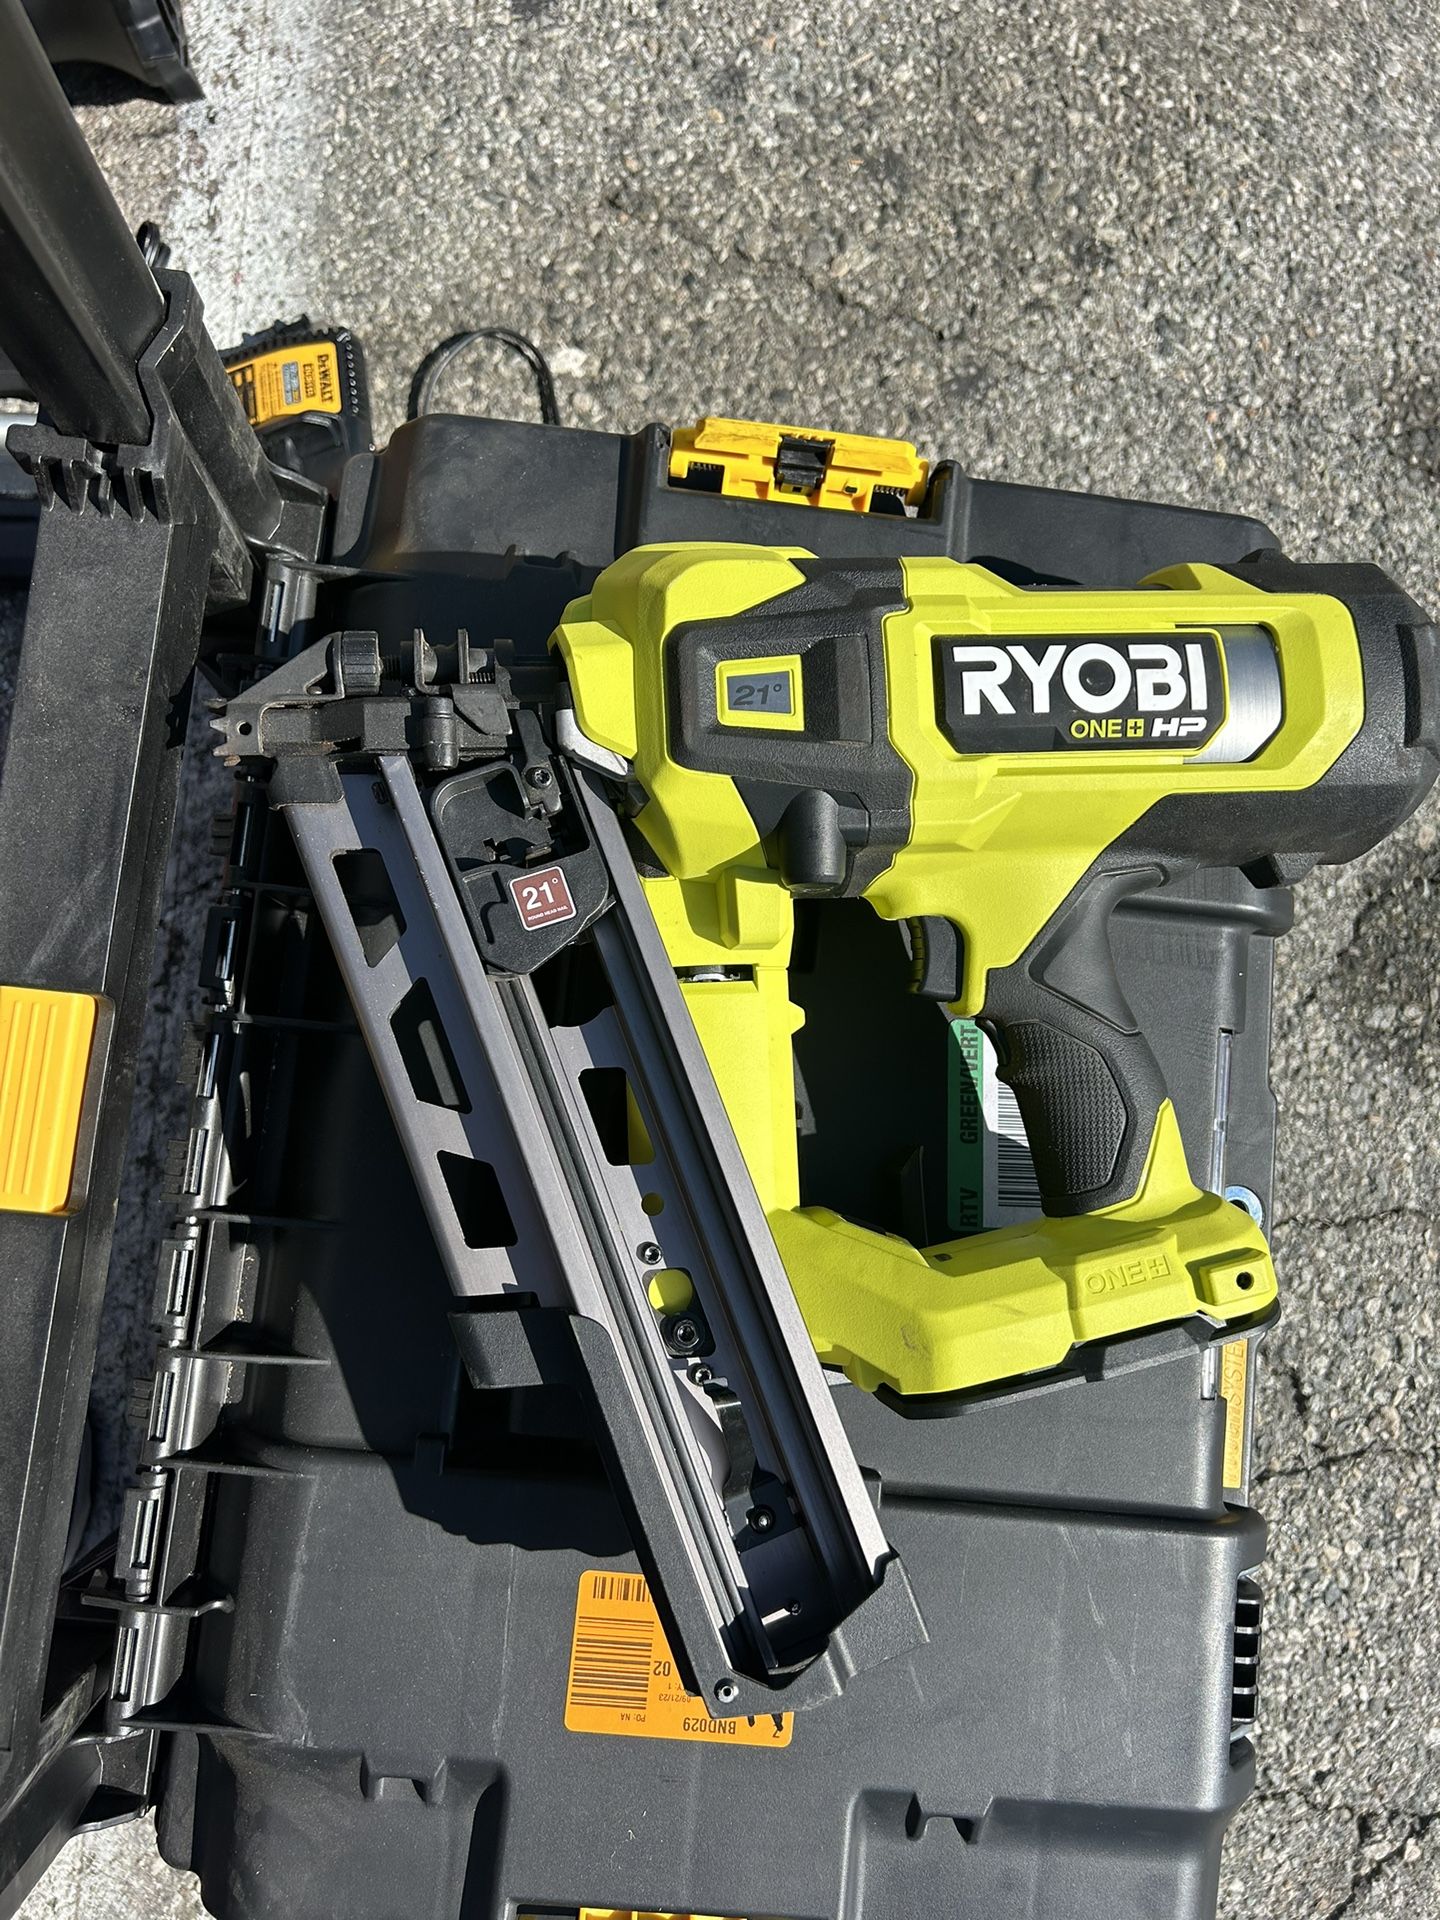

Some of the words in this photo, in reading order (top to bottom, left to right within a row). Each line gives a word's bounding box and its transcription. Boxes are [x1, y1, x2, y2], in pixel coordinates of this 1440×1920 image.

[952, 643, 1208, 715] RYOBI
[733, 683, 782, 706] 21°
[1150, 717, 1207, 737] HP
[522, 878, 558, 910] 21°
[960, 1024, 978, 1145] GREEN/VERT
[960, 1187, 978, 1227] RTV
[653, 1661, 671, 1677] 02
[620, 1712, 631, 1721] NA
[683, 1716, 737, 1735] BND029
